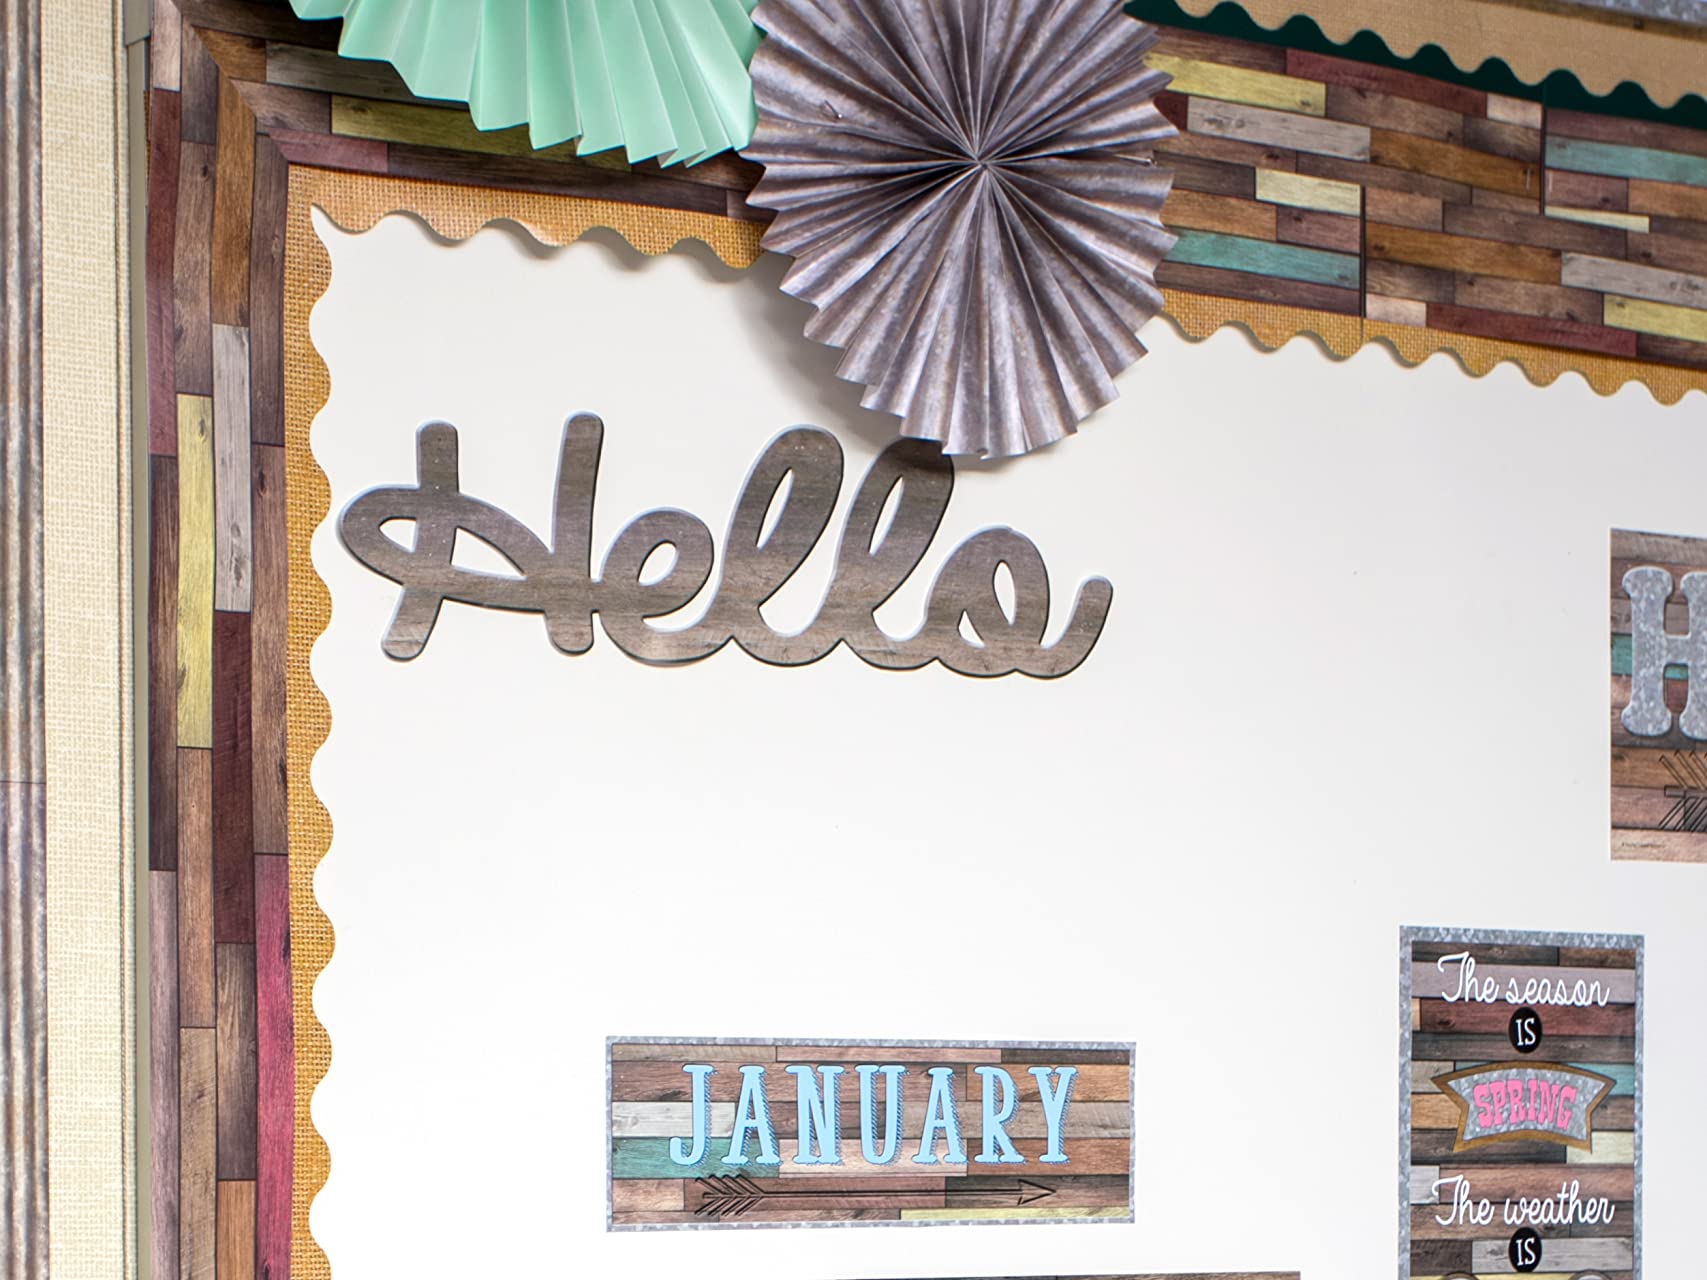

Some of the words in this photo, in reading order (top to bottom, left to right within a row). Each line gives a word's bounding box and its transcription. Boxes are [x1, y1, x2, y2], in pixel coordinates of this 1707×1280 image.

[337, 410, 1115, 680] Hello
[1437, 951, 1499, 1003] The
[1505, 976, 1611, 1007] season
[1515, 1017, 1536, 1047] IS
[669, 1064, 1081, 1167] JANUARY
[1473, 1079, 1578, 1129] SPRING
[1431, 1174, 1495, 1226] The
[1503, 1179, 1615, 1225] weather
[1516, 1237, 1536, 1266] IS
